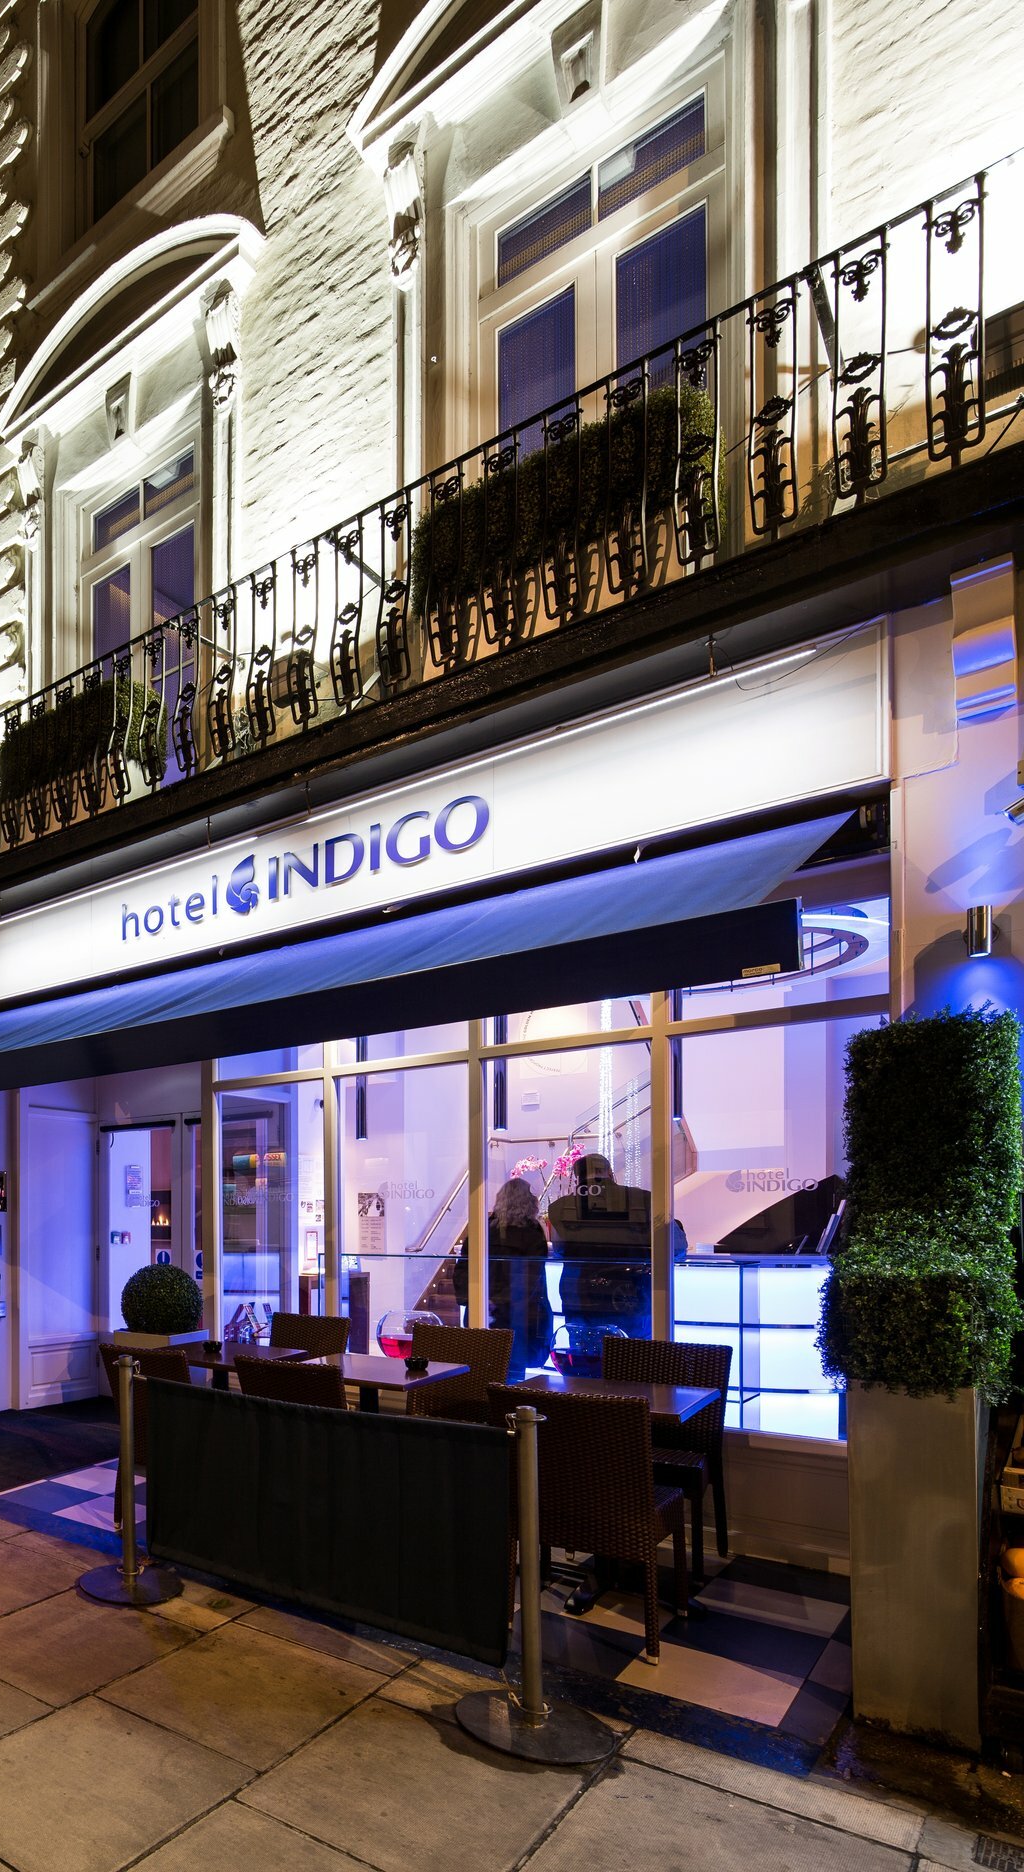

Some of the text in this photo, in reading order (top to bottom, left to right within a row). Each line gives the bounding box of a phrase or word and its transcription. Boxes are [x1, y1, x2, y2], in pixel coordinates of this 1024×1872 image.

[121, 795, 490, 941] hotel INDIGO
[747, 1168, 789, 1180] hotel
[390, 1180, 418, 1189] hotel
[747, 1178, 818, 1192] INDIGO
[390, 1189, 435, 1200] INDIGO
